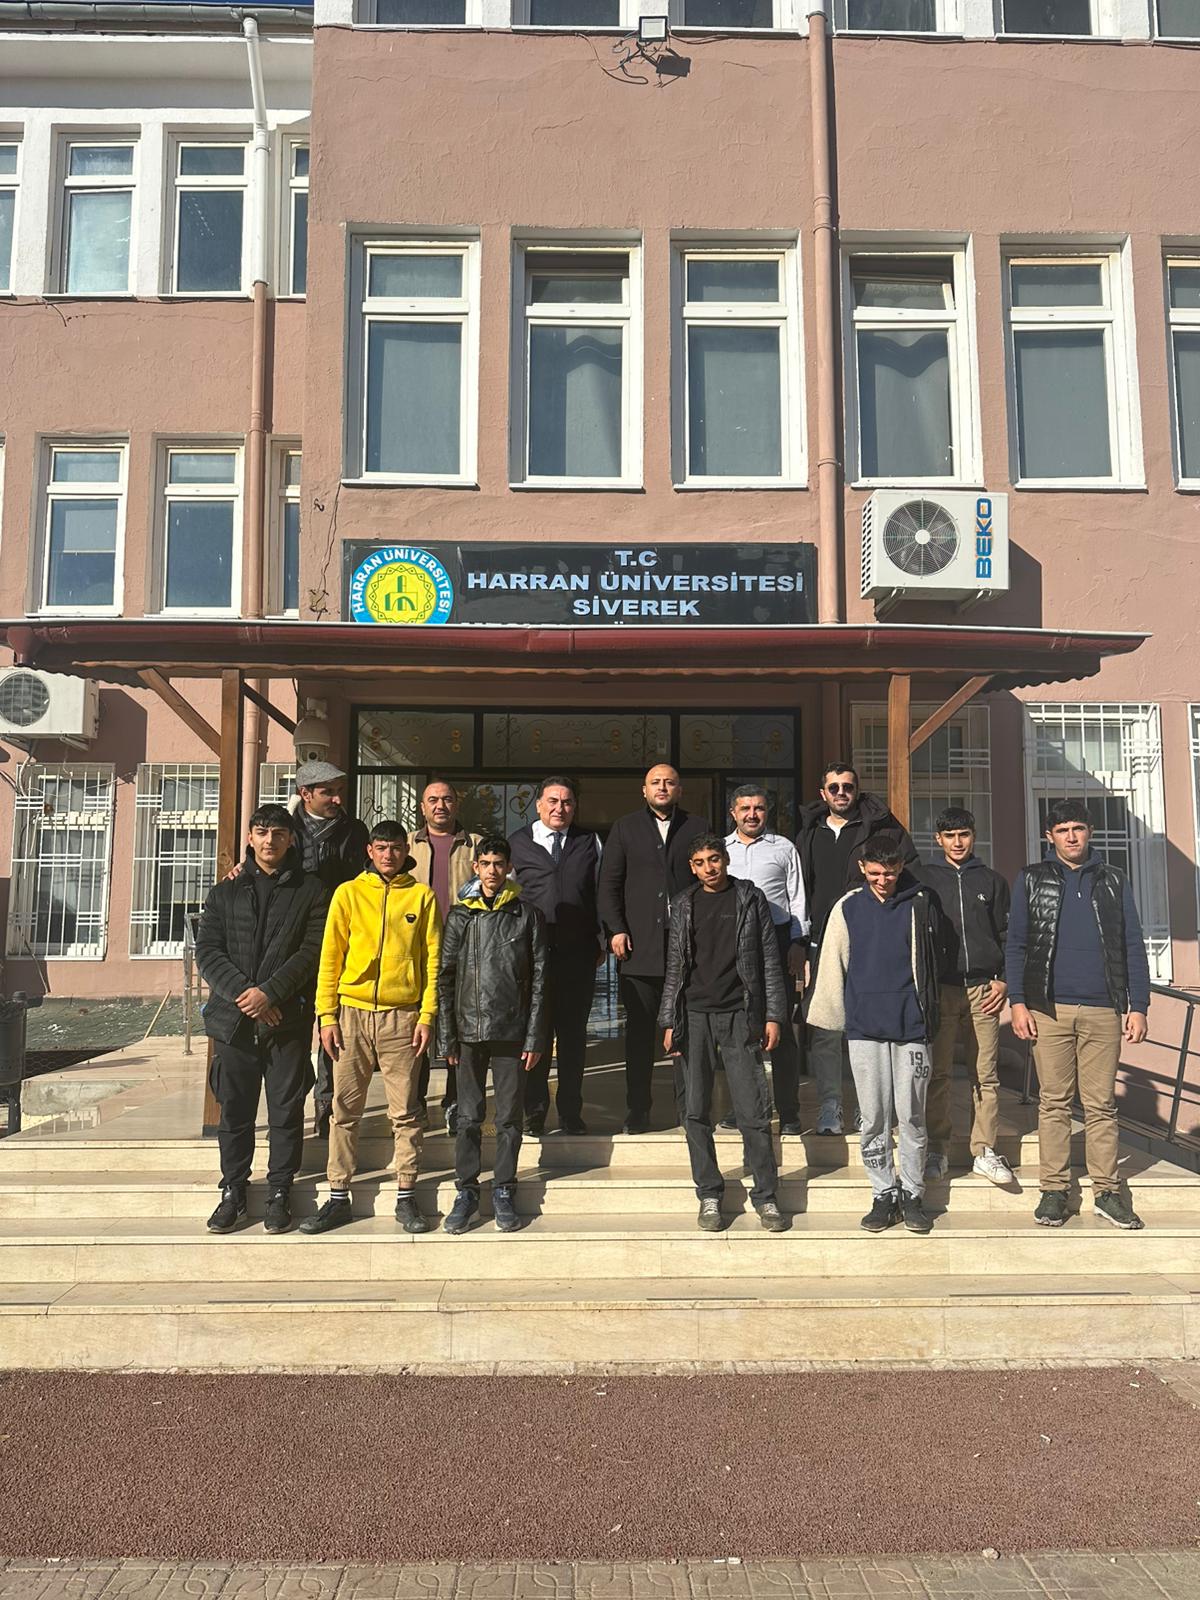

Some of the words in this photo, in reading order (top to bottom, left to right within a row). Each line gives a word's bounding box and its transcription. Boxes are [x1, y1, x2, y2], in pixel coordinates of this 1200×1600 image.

[976, 498, 992, 578] BEKO
[614, 550, 658, 567] T.C
[351, 554, 383, 613] HARRAN
[467, 572, 590, 590] HARRAN
[600, 571, 804, 592] ÜNİVERSİTESİ
[572, 595, 700, 616] SİVEREK
[909, 1050, 923, 1066] 19
